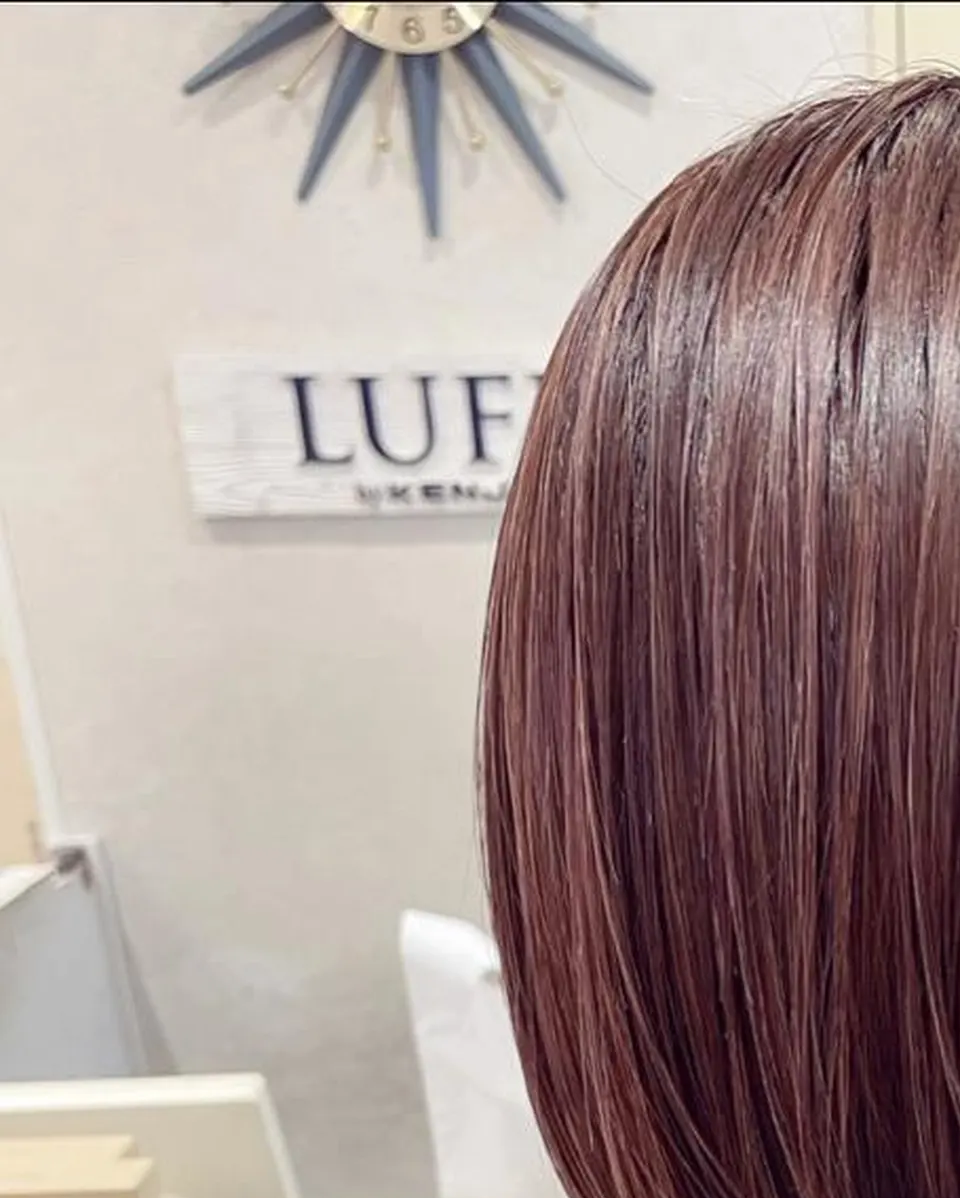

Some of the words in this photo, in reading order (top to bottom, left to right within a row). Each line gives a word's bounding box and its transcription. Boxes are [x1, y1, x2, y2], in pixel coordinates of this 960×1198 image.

[366, 6, 379, 33] 7
[402, 17, 426, 45] 6
[281, 373, 545, 466] LUF
